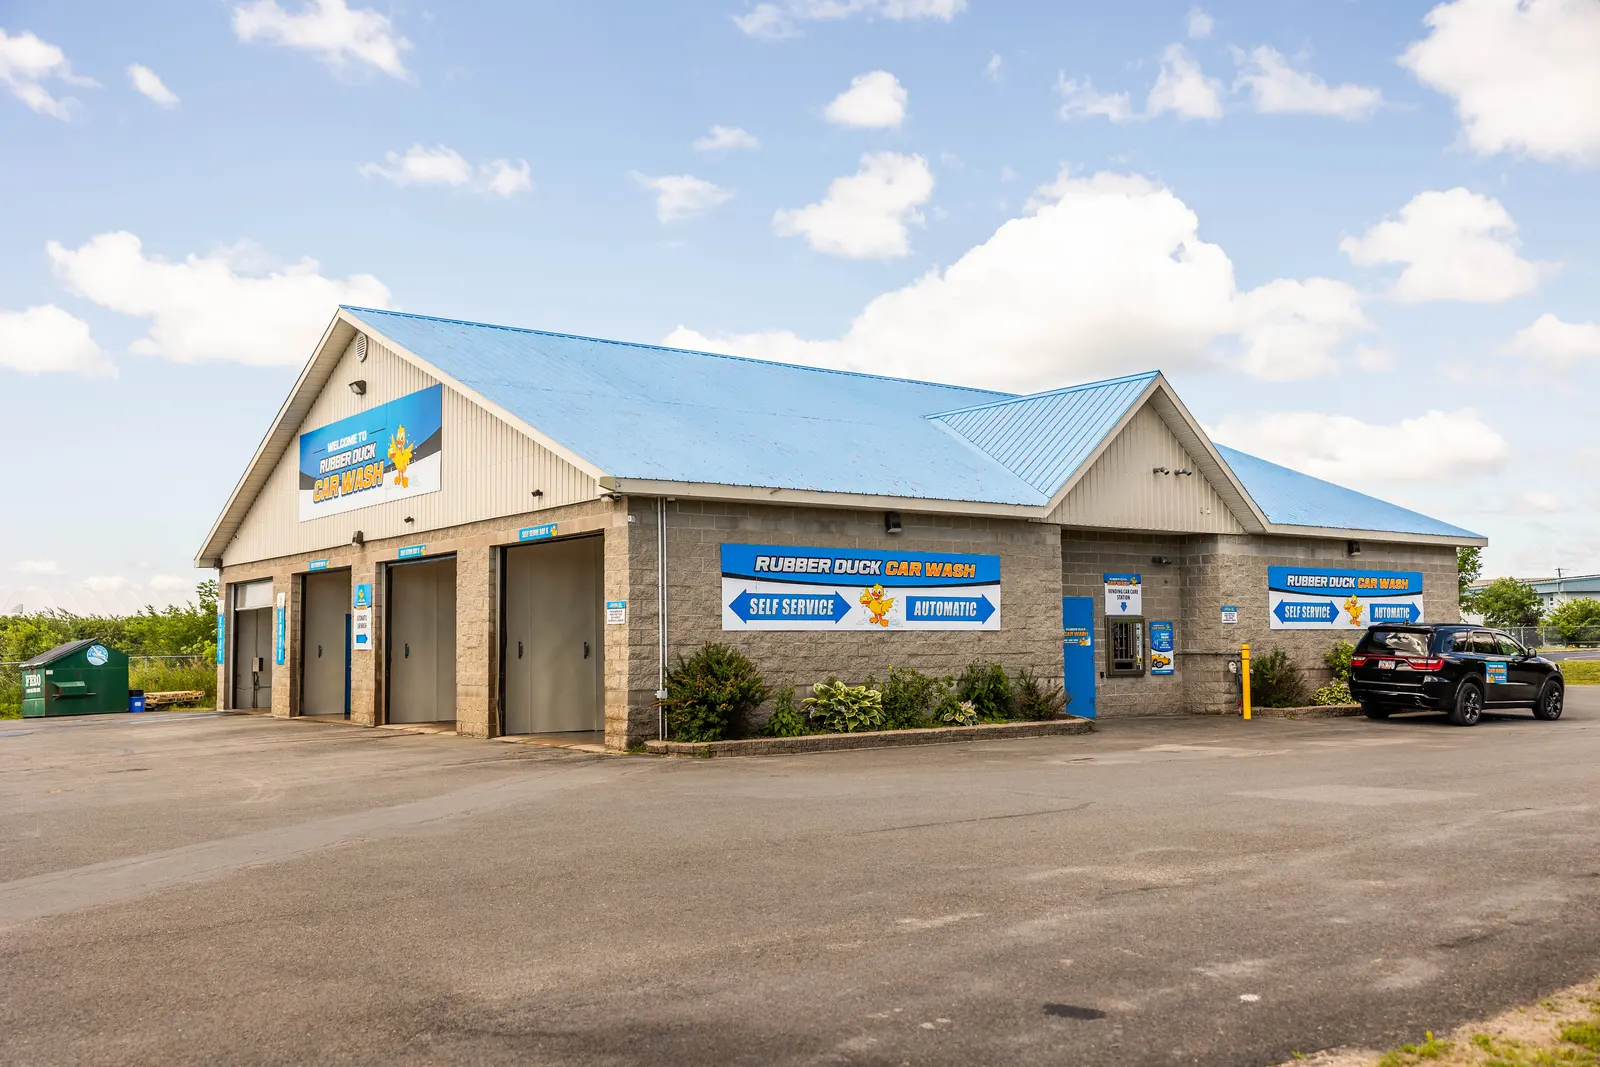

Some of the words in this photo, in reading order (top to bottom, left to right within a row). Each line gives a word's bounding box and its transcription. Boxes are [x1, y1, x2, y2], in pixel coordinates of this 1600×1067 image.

[328, 434, 357, 452] WELCOME
[357, 430, 367, 442] TO
[319, 449, 352, 475] RUBBER
[351, 441, 378, 464] DUCK
[313, 474, 340, 503] CAR
[341, 459, 384, 496] WASH
[754, 555, 831, 574] RUBBER
[833, 558, 883, 576] DUCK
[885, 560, 922, 577] CAR
[925, 562, 977, 579] WASH
[1287, 574, 1327, 588] RUBBER
[1328, 576, 1356, 589] DUCK
[1357, 577, 1378, 589] CAR
[1379, 578, 1409, 590] WASH
[749, 598, 778, 615] SELF
[781, 598, 834, 616] SERVICE
[914, 600, 977, 616] AUTOMATIC
[1284, 605, 1300, 618] SELF
[1302, 606, 1331, 618] SERVICE
[1374, 606, 1410, 619] AUTOMATIC
